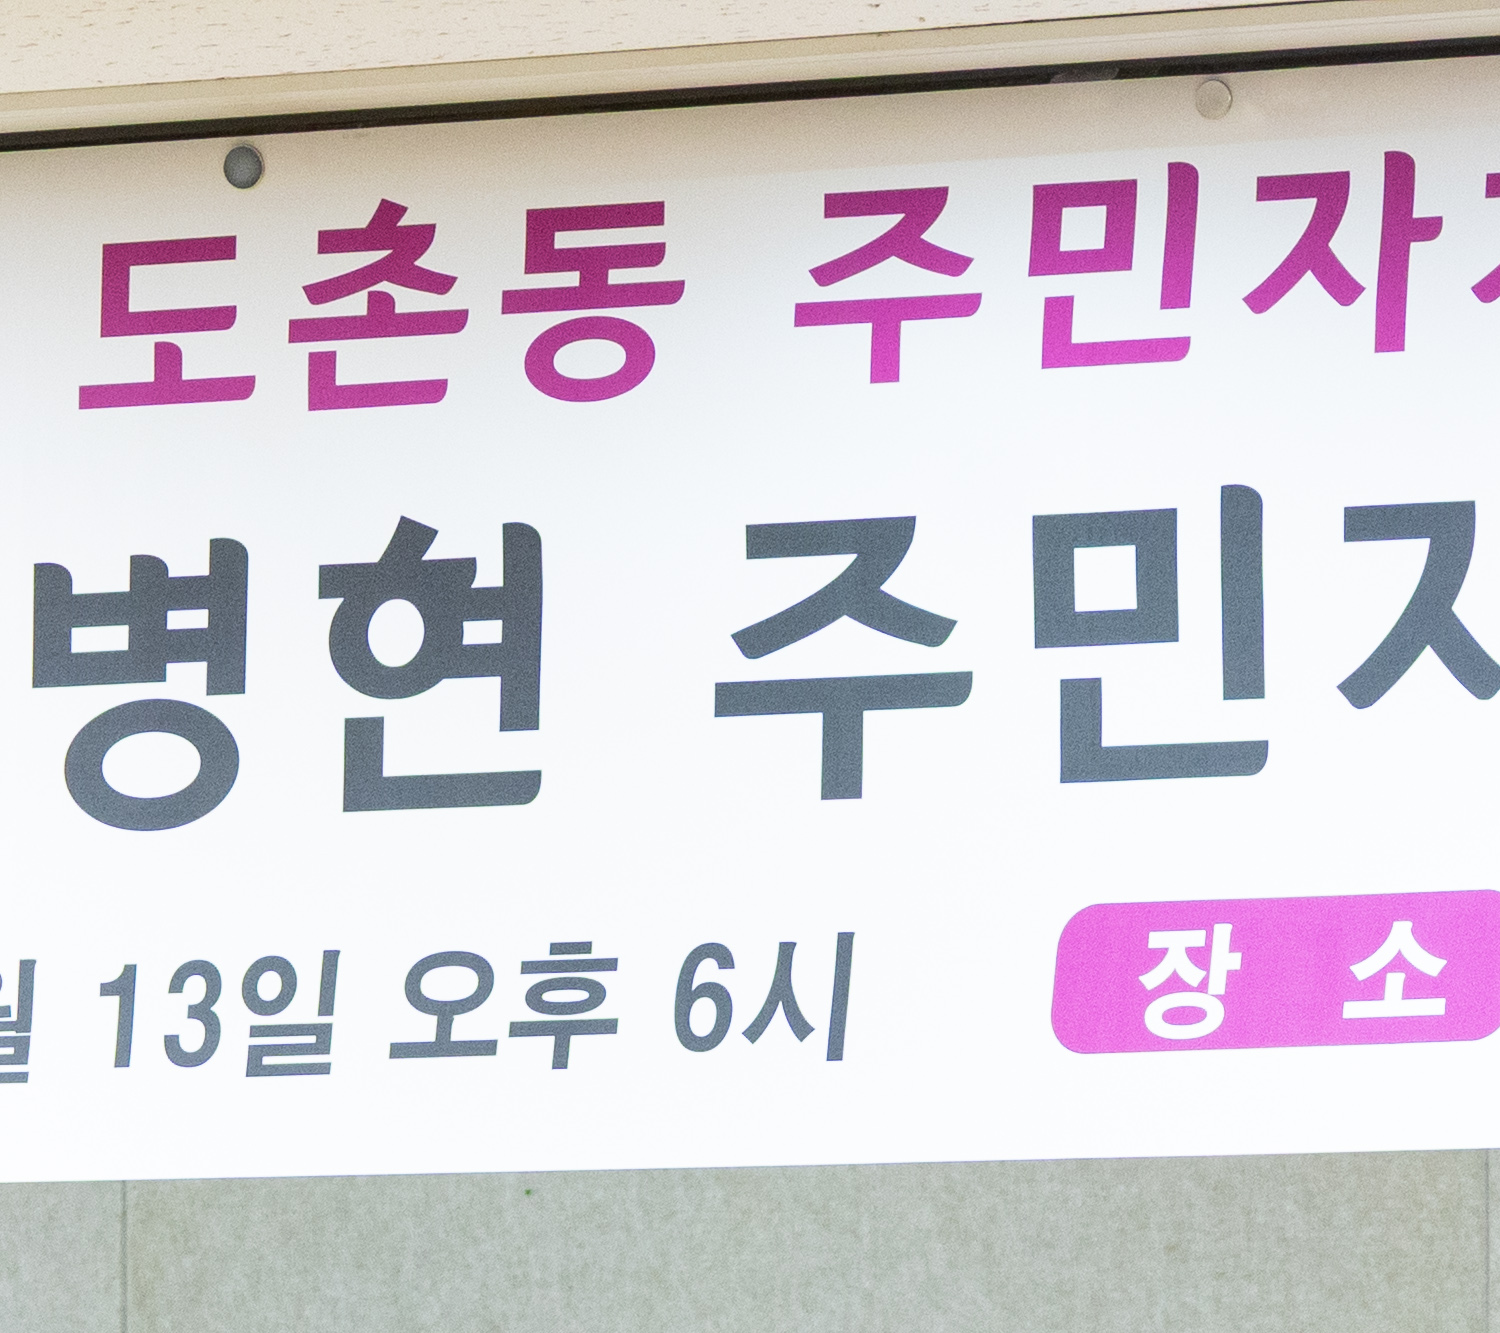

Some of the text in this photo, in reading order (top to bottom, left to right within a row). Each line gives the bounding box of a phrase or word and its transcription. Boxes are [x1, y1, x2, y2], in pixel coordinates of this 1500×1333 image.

[78, 197, 686, 412] 도촌동
[99, 949, 341, 1079] 13일
[388, 940, 619, 1070] 오후
[673, 931, 855, 1062] 6시
